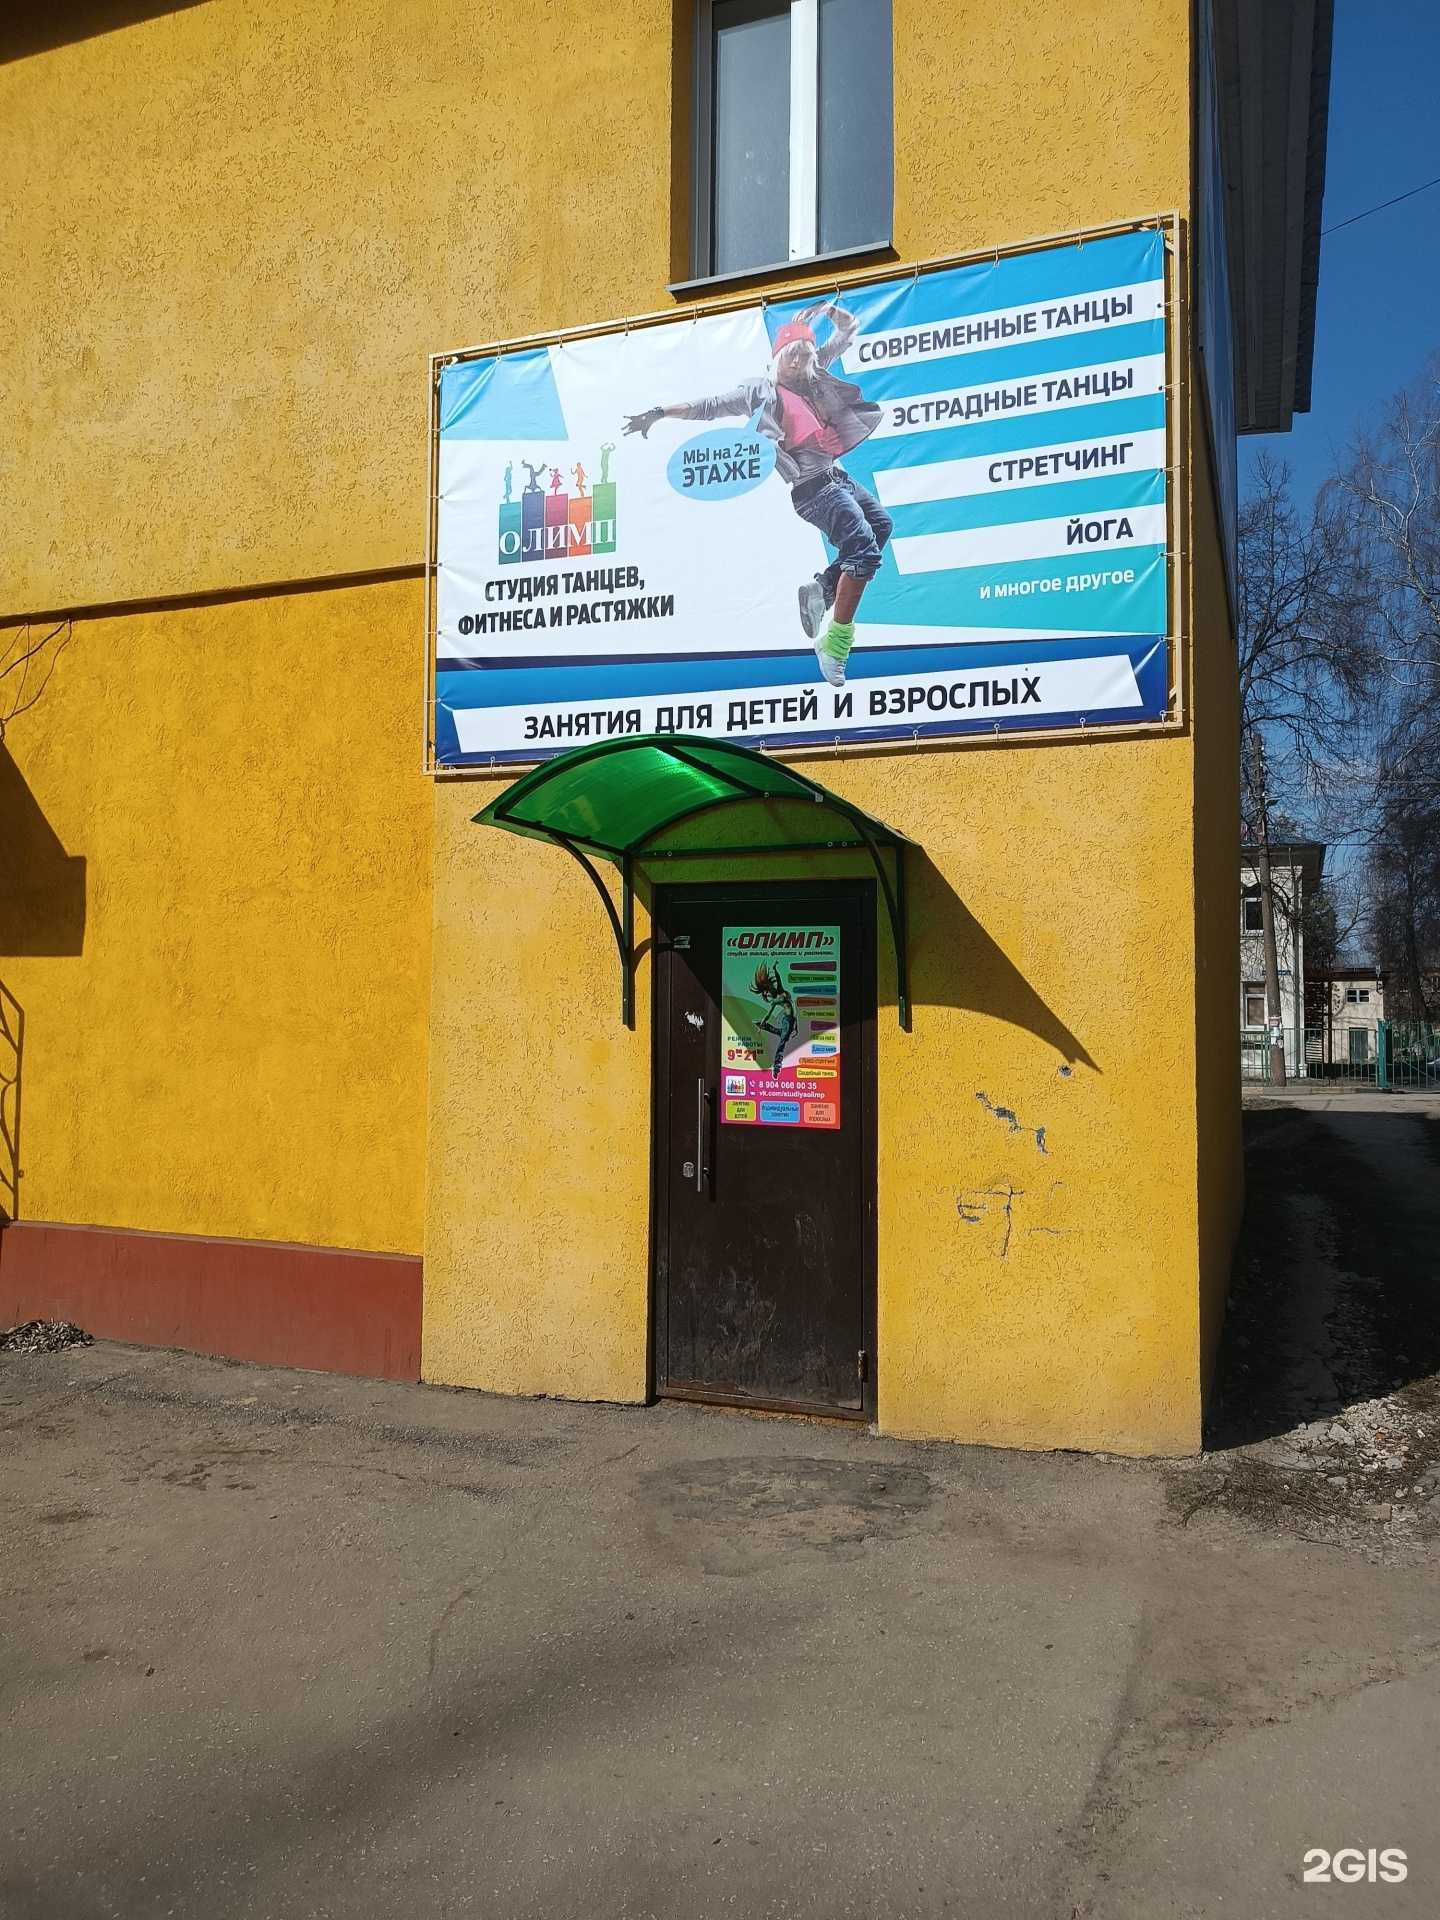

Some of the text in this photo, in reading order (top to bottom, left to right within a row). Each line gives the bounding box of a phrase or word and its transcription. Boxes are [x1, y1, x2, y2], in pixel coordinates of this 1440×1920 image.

[858, 293, 1134, 364] СОВРЕМЕННЫЕ ТАНЦЫ
[892, 367, 1134, 428] ЭСТРАДНЫЕ ТАНЦЫ
[683, 443, 760, 464] МЫ на 2-м
[988, 442, 1134, 483] СТРЕТЧИНГ
[682, 458, 761, 488] ЭТАЖЕ
[499, 519, 616, 556] ОЛИМП
[1066, 517, 1134, 546] ЙОГА
[485, 565, 645, 603] СТУДИЯ ТАНЦЕВ,
[980, 568, 1135, 600] и многое другое
[458, 594, 674, 636] ФИТНЕСА И РАСТЯЖКИ
[524, 676, 1042, 739] ЗАНЯТИЯ ДЛЯ ДЕТЕЙ И ВЗРОСЛЫХ
[727, 932, 834, 949] «ОЛИМП»
